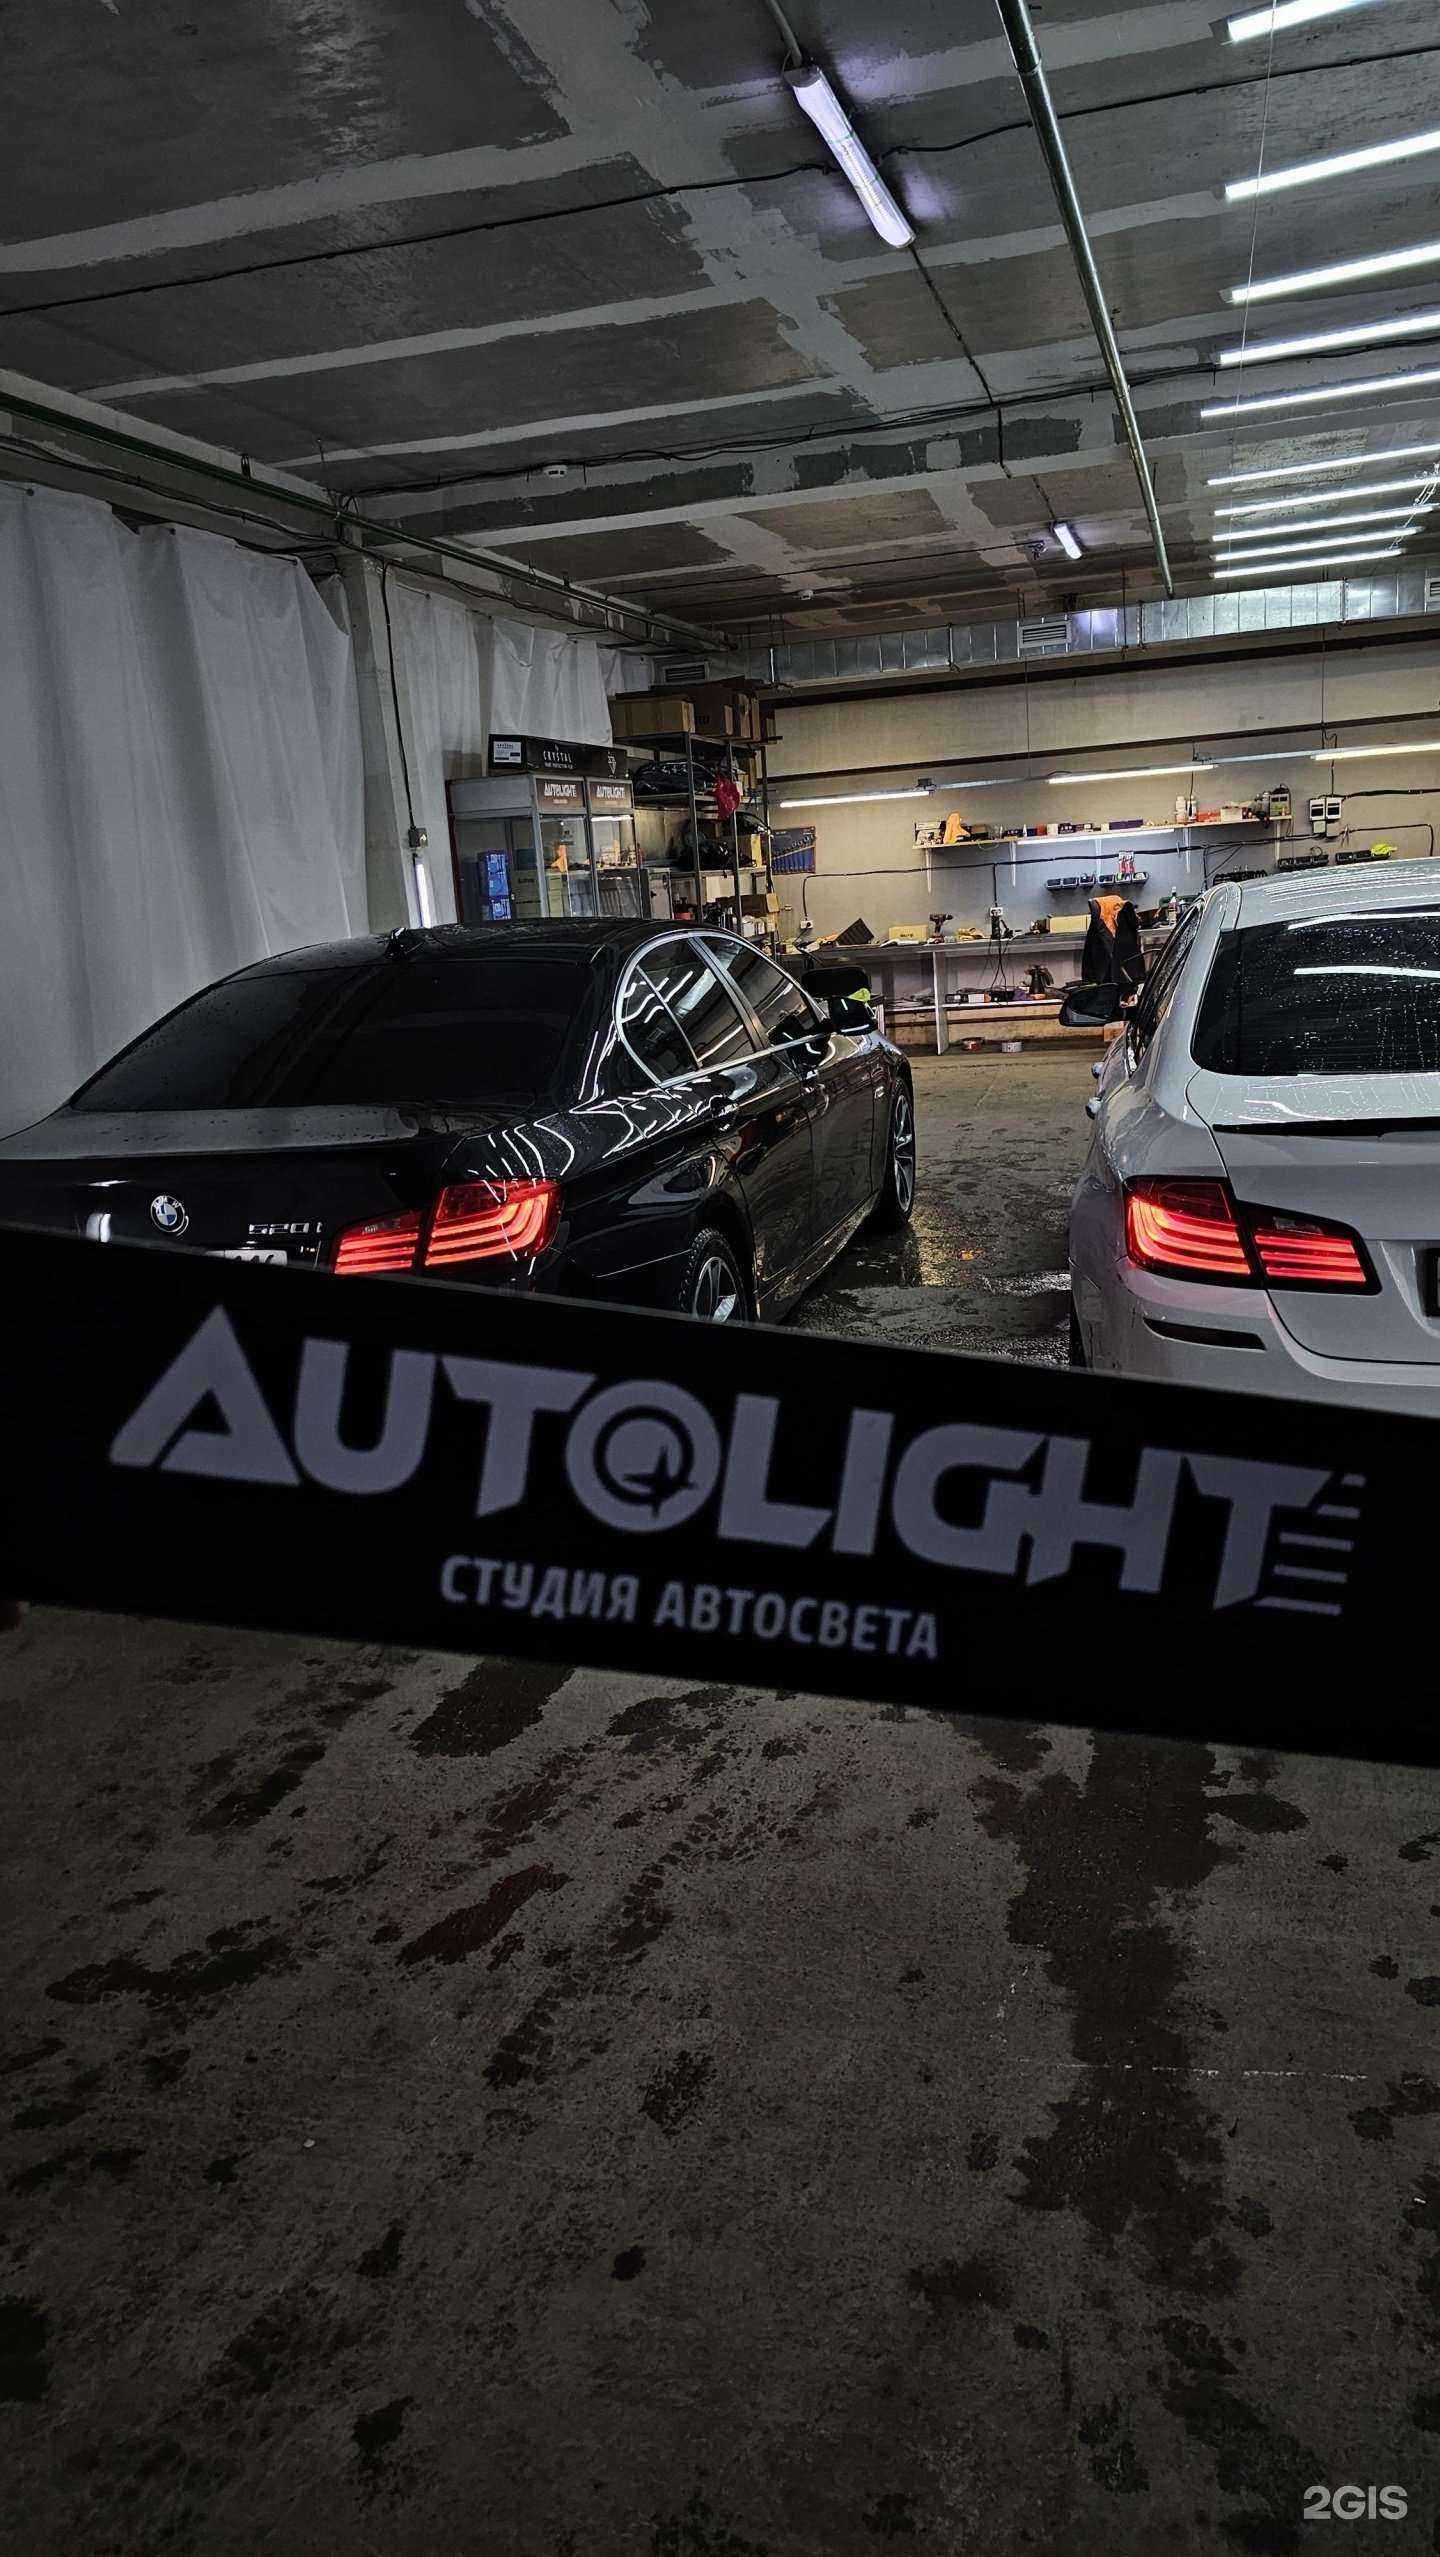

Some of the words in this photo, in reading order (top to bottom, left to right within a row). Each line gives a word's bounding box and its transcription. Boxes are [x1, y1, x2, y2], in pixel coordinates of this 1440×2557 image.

[109, 1305, 1365, 1614] AUTOLIGHT
[440, 1554, 640, 1621] СТУДИЯ
[653, 1580, 938, 1660] АВТОСВЕТА
